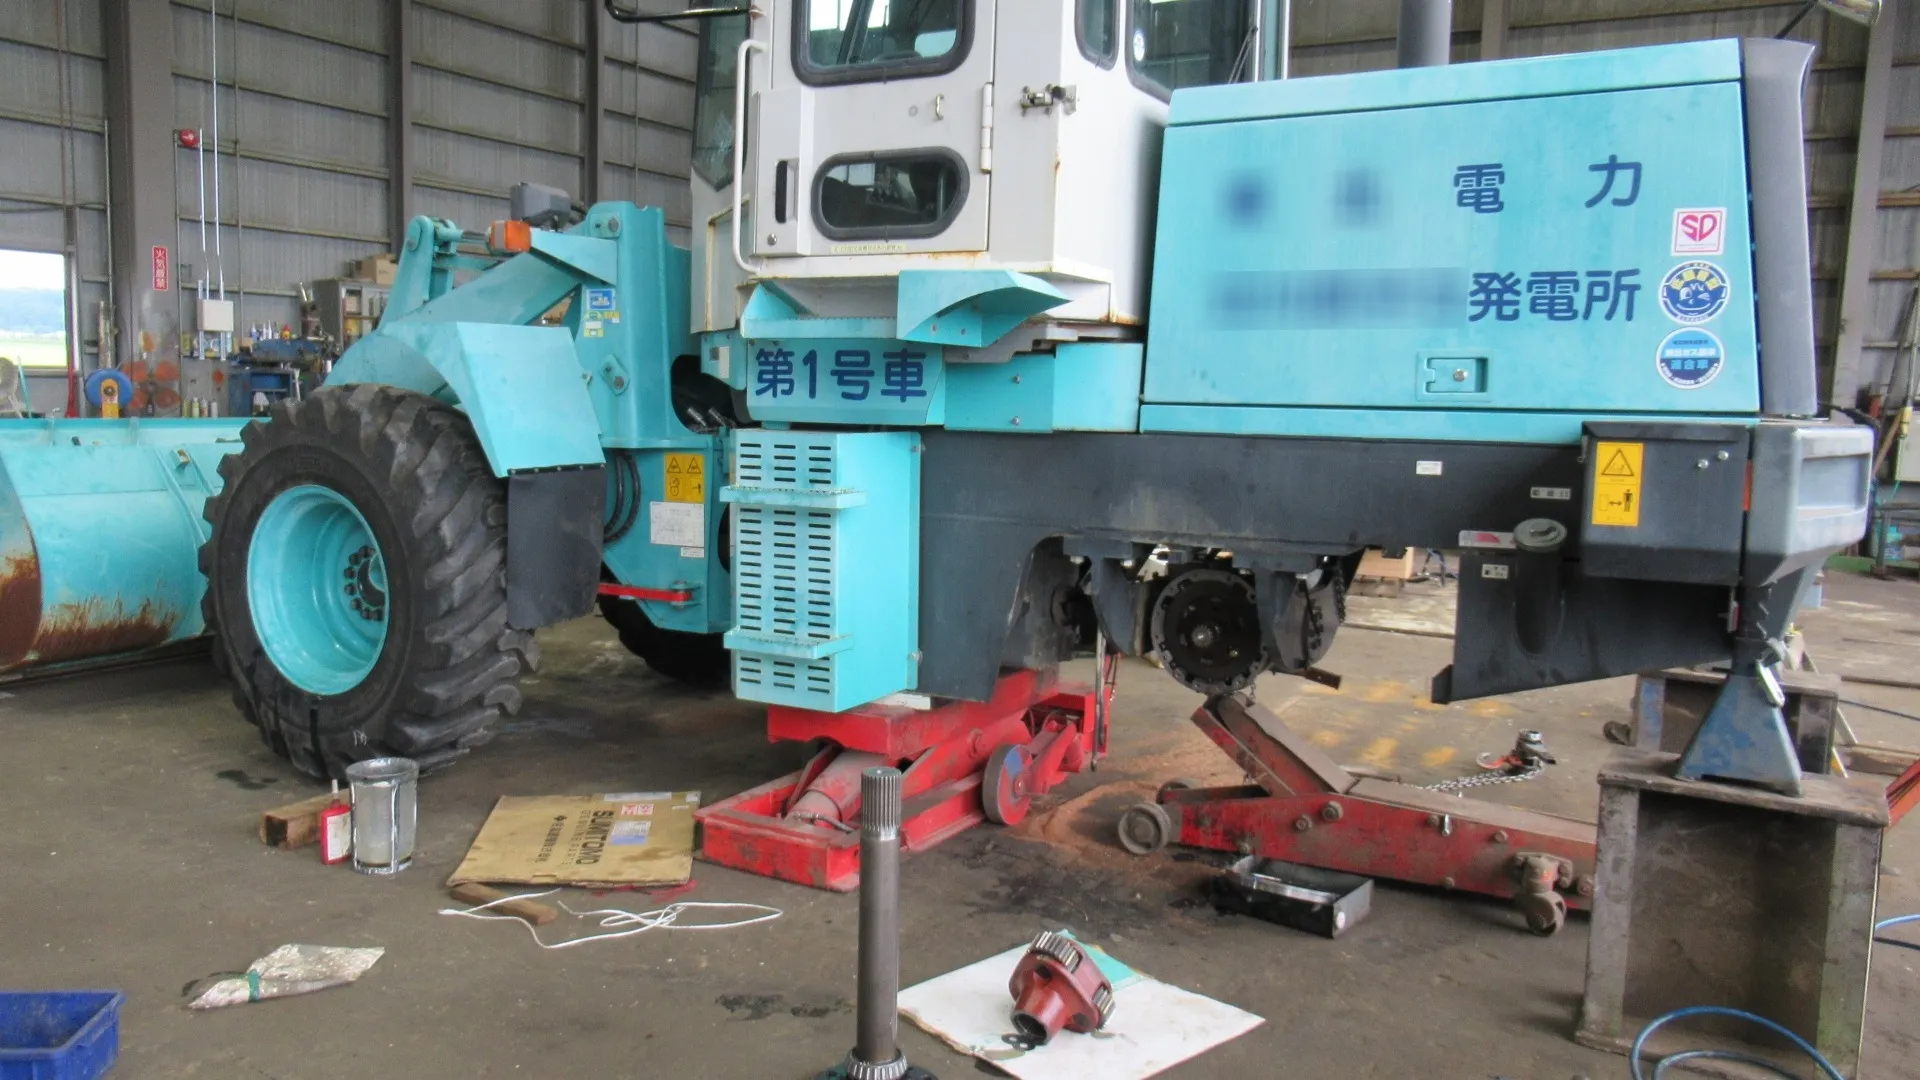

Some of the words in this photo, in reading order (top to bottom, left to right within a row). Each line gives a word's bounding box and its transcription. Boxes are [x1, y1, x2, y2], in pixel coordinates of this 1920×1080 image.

[1681, 213, 1718, 242] SD
[1468, 268, 1641, 322] 発電所
[755, 347, 928, 403] 第1号車
[575, 810, 615, 865] SUMITOMO
